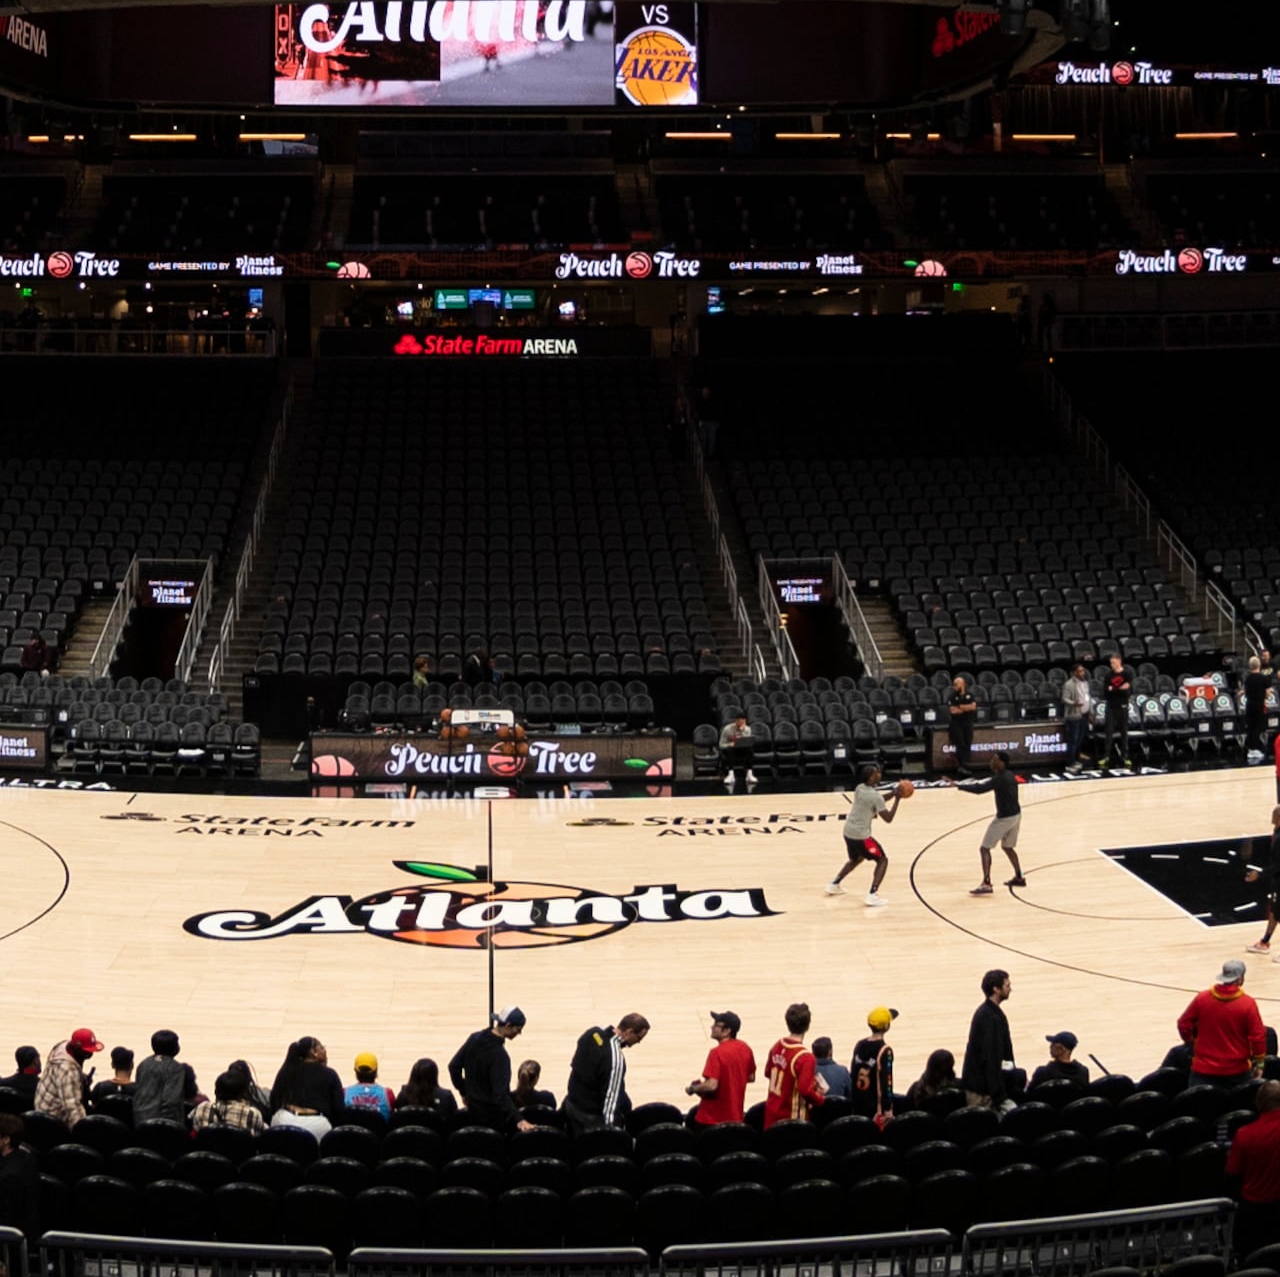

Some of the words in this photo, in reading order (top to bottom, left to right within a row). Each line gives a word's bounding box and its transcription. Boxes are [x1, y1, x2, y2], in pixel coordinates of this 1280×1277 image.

[641, 5, 668, 24] VS
[6, 14, 48, 58] ARENA
[1056, 62, 1110, 84] Peach
[1134, 62, 1172, 84] Tree
[74, 252, 119, 276] Tree
[235, 255, 275, 276] planet
[240, 265, 283, 276] fitness
[555, 253, 622, 278] Peach
[651, 252, 700, 276] Tree
[816, 254, 855, 275] planet
[821, 264, 863, 275] fitness
[1116, 250, 1175, 274] Peach
[1203, 248, 1246, 271] Tree
[424, 334, 472, 356] State
[474, 334, 521, 356] Farm
[523, 337, 578, 356] ARENA
[1009, 740, 1020, 750] BY
[1024, 733, 1061, 754] planet
[1029, 741, 1068, 754] fitness
[385, 742, 483, 774] Peach
[528, 741, 597, 774] Tree
[174, 826, 326, 837] ARENA
[656, 825, 805, 837] ARENA
[183, 884, 785, 940] Atlanta
